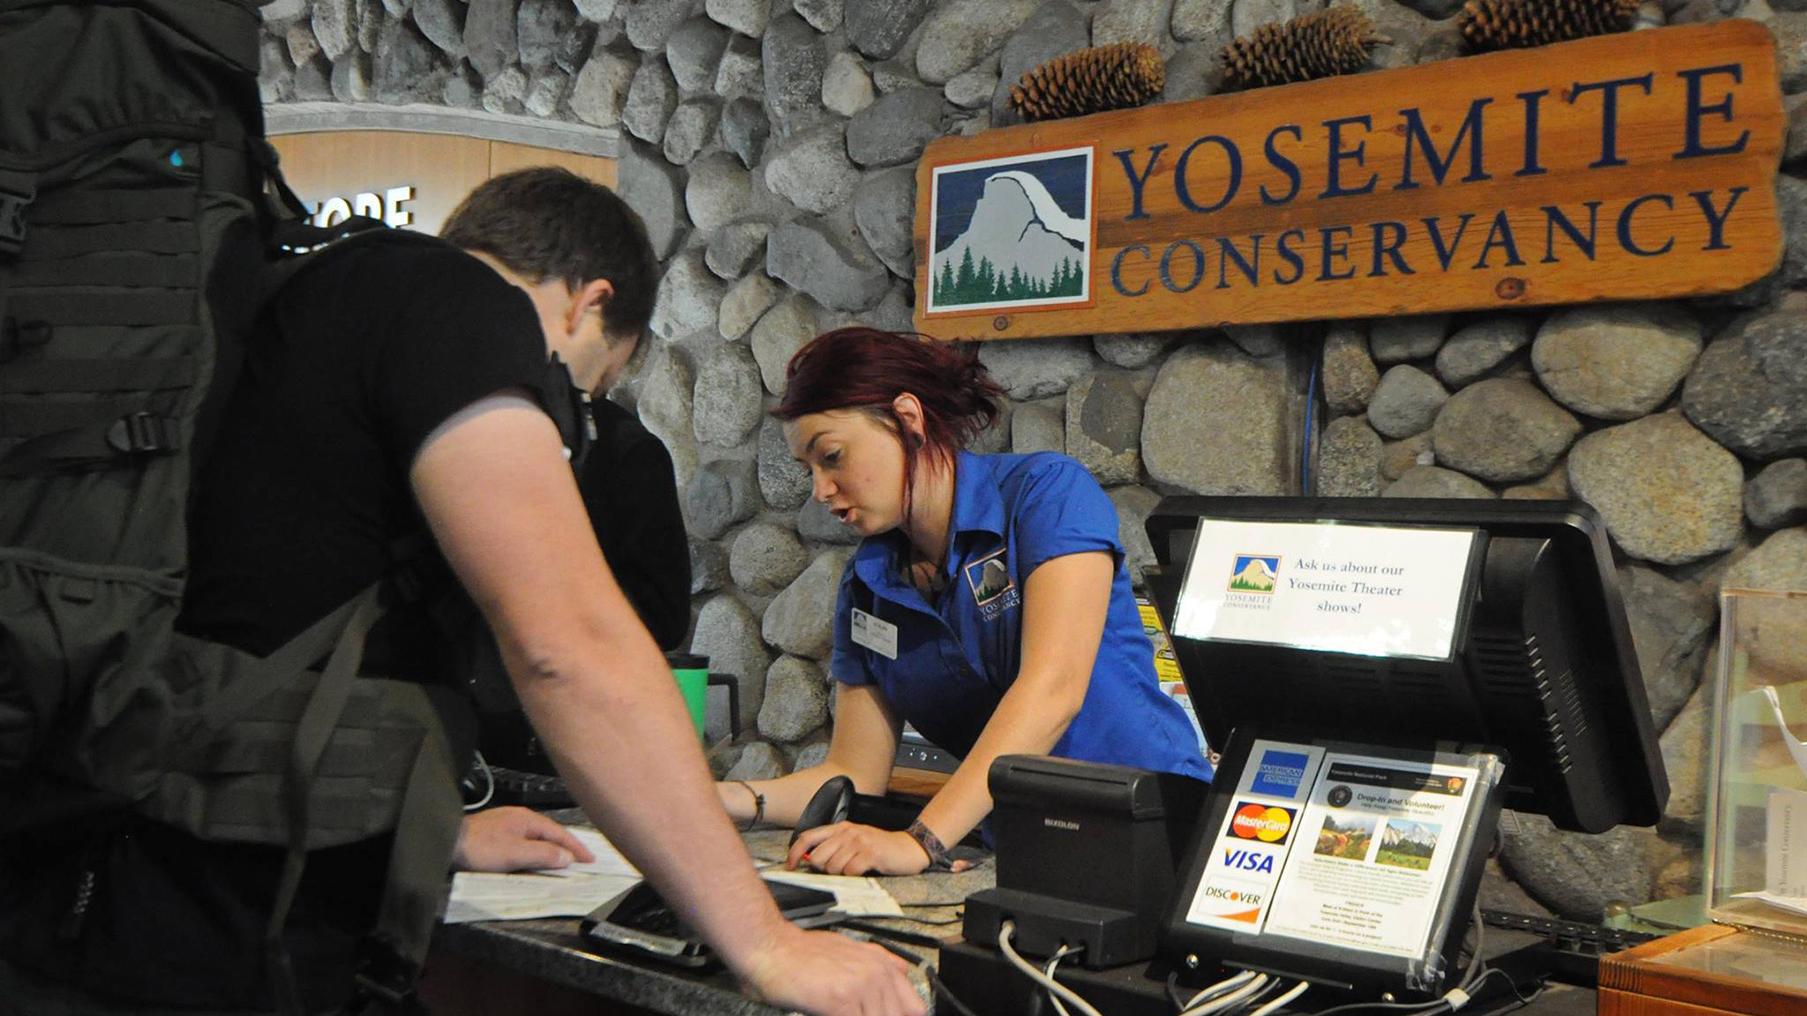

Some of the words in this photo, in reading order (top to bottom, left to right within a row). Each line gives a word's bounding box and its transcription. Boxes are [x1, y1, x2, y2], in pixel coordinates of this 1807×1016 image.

[1112, 62, 1751, 221] YOSEMITE
[1111, 186, 1749, 297] CONSERVANCY
[1294, 558, 1318, 571] Ask
[1322, 561, 1336, 572] us
[1340, 561, 1378, 575] about
[1381, 566, 1405, 576] our
[1289, 577, 1347, 592] Yosemite
[1352, 581, 1403, 596] Theater
[1224, 593, 1272, 604] YOSEMITE
[1317, 601, 1362, 614] shows!
[1261, 763, 1303, 778] AMERICAN
[1263, 774, 1301, 786] EXPRESS
[1404, 799, 1445, 811] Volunteer!
[1233, 814, 1289, 832] MasterCard
[1224, 848, 1274, 873] VISA
[1205, 886, 1262, 905] DISCOVER
